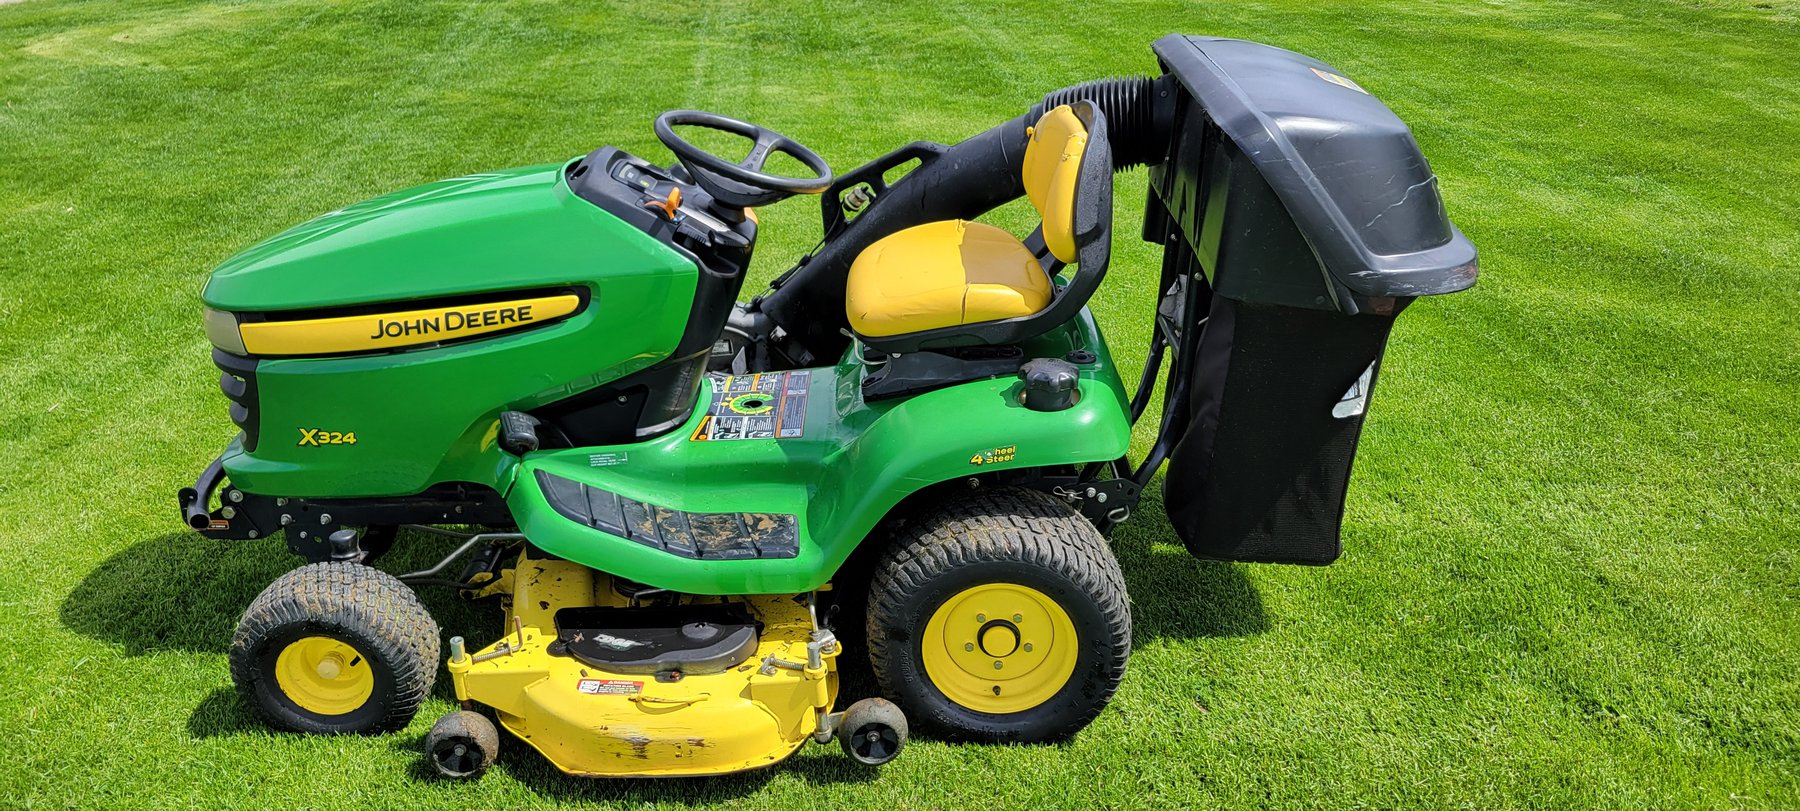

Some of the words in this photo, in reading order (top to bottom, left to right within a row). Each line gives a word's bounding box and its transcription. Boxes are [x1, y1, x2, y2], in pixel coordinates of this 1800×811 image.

[371, 317, 440, 339] JOHN
[444, 305, 533, 331] DEERE
[298, 428, 357, 446] X324
[970, 454, 983, 465] 4
[986, 454, 1015, 464] Steer
